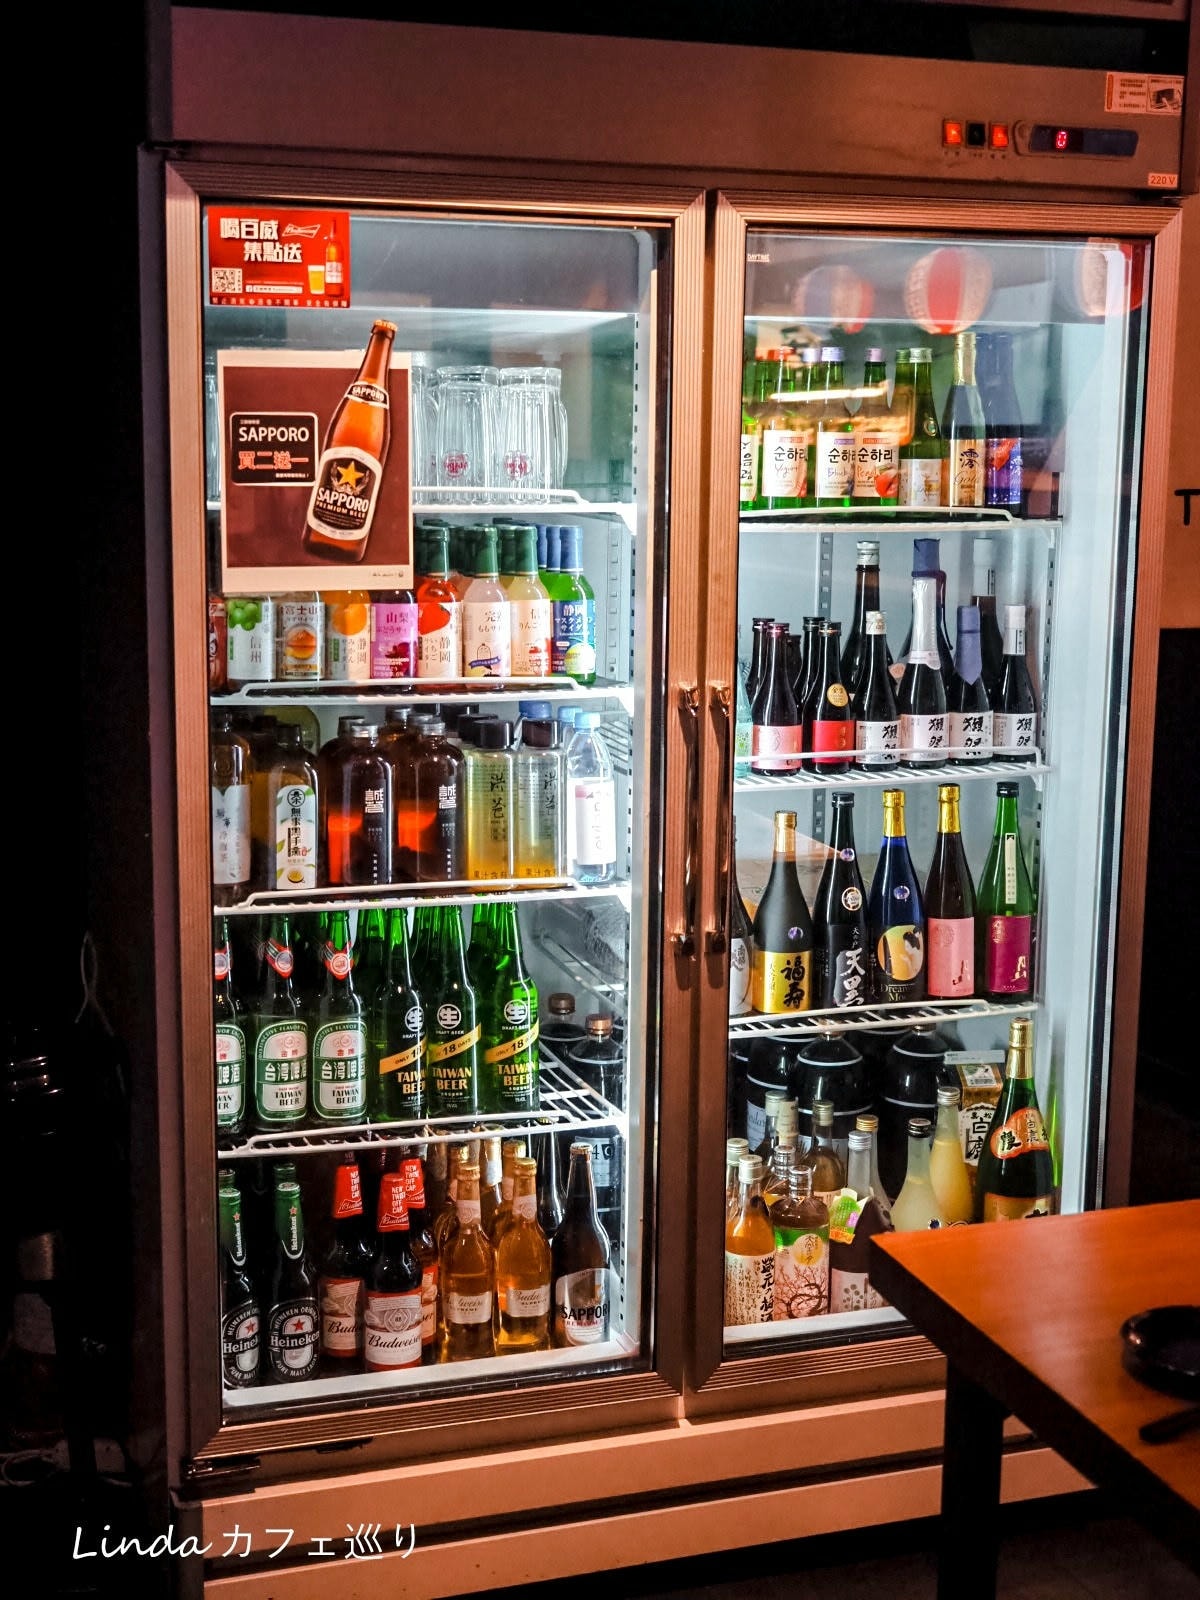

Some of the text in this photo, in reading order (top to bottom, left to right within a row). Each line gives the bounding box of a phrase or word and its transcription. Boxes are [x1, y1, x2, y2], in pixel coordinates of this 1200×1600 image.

[1150, 175, 1167, 185] 220
[219, 217, 279, 240] 喝百威
[243, 241, 303, 263] 集點送
[352, 385, 384, 401] SAPPORO
[239, 426, 309, 442] SAPPORO
[857, 446, 893, 463] 순하리
[316, 487, 370, 513] SAPPORO
[442, 1044, 456, 1057] 18
[511, 1039, 524, 1052] 18
[432, 1066, 472, 1079] TAIWAN
[436, 1078, 468, 1091] BEER
[503, 1073, 533, 1086] BEER
[275, 1089, 303, 1099] TAIWAN
[332, 1089, 360, 1098] TAIWAN
[279, 1098, 300, 1106] BEER
[336, 1097, 358, 1105] BEER
[290, 1216, 298, 1251] Heineken
[274, 1308, 299, 1330] HEINEKEN
[270, 1331, 320, 1348] Heineken
